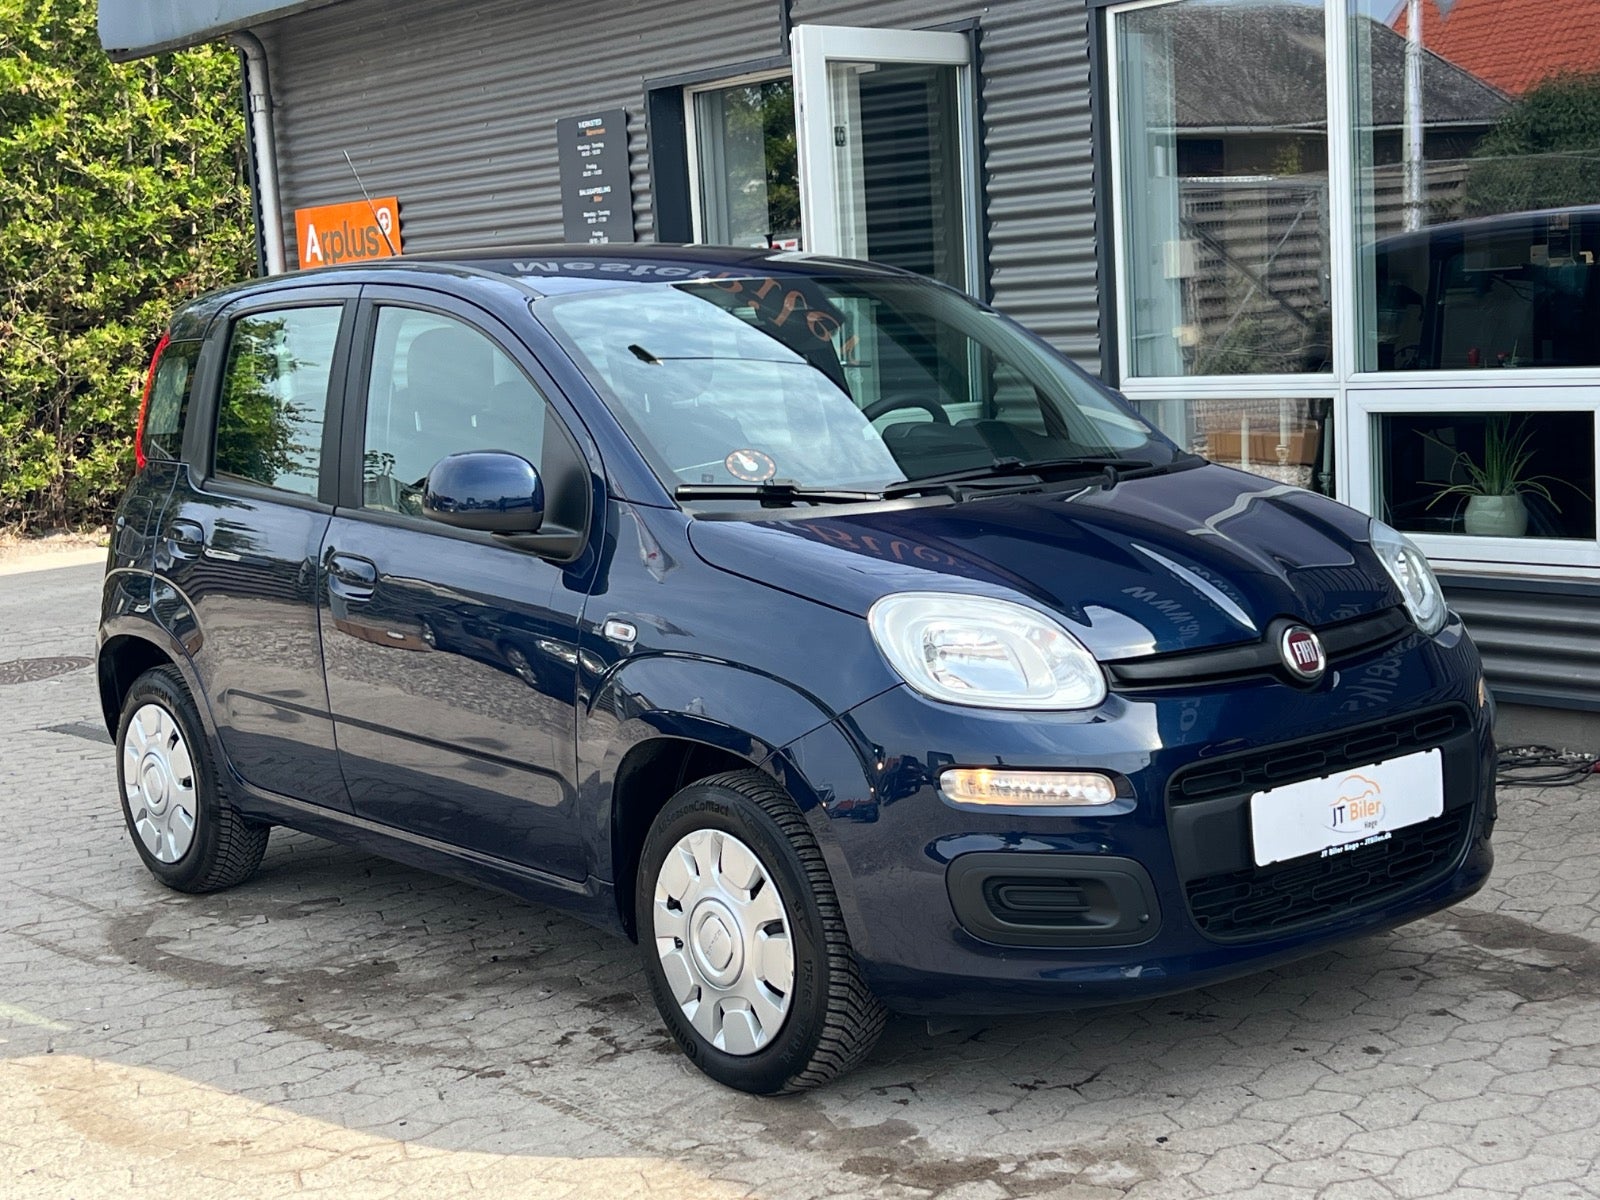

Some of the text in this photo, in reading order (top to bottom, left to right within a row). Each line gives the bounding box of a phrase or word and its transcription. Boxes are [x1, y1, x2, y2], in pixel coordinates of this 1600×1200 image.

[1292, 640, 1318, 665] FIAT
[1332, 800, 1381, 827] JT Biler
